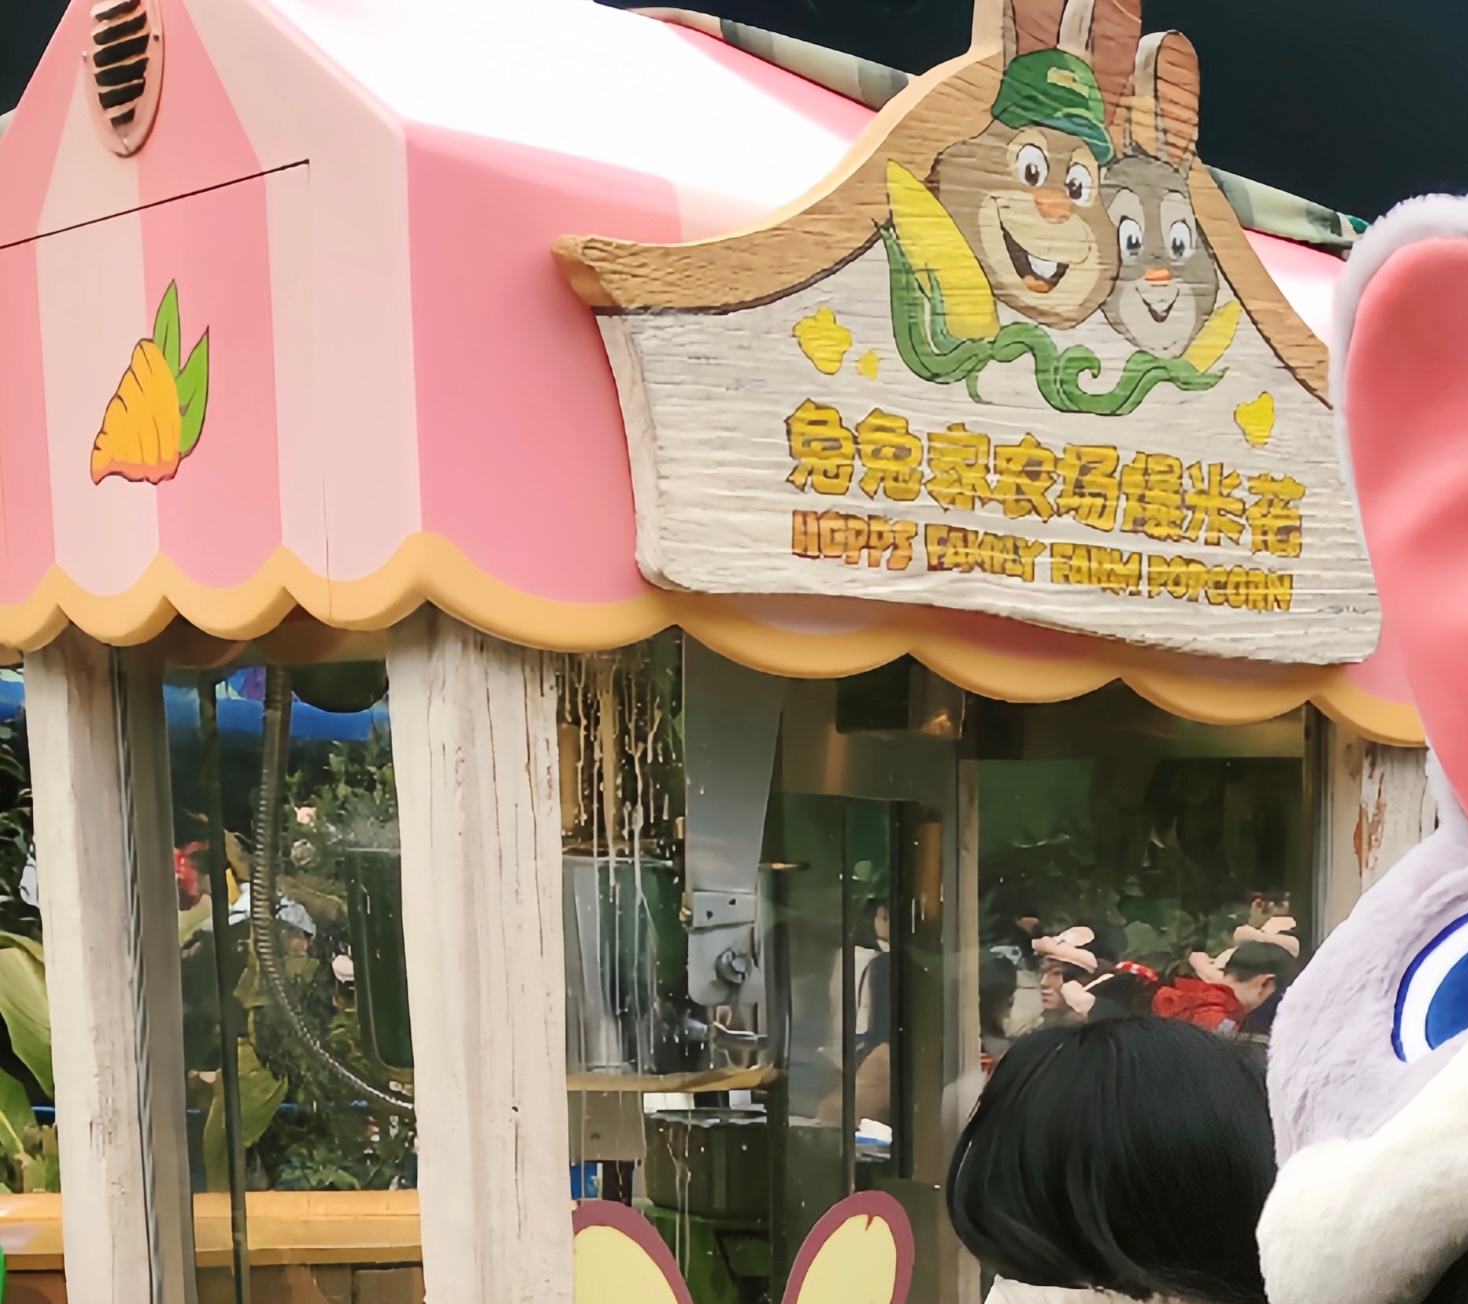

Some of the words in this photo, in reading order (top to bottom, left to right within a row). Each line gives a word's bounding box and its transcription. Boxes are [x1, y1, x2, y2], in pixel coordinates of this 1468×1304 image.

[785, 397, 1306, 559] 兔兔家农场爆米花
[924, 522, 1048, 583] FAMILY
[1050, 541, 1142, 597] FARM
[1147, 554, 1294, 612] POPCORN
